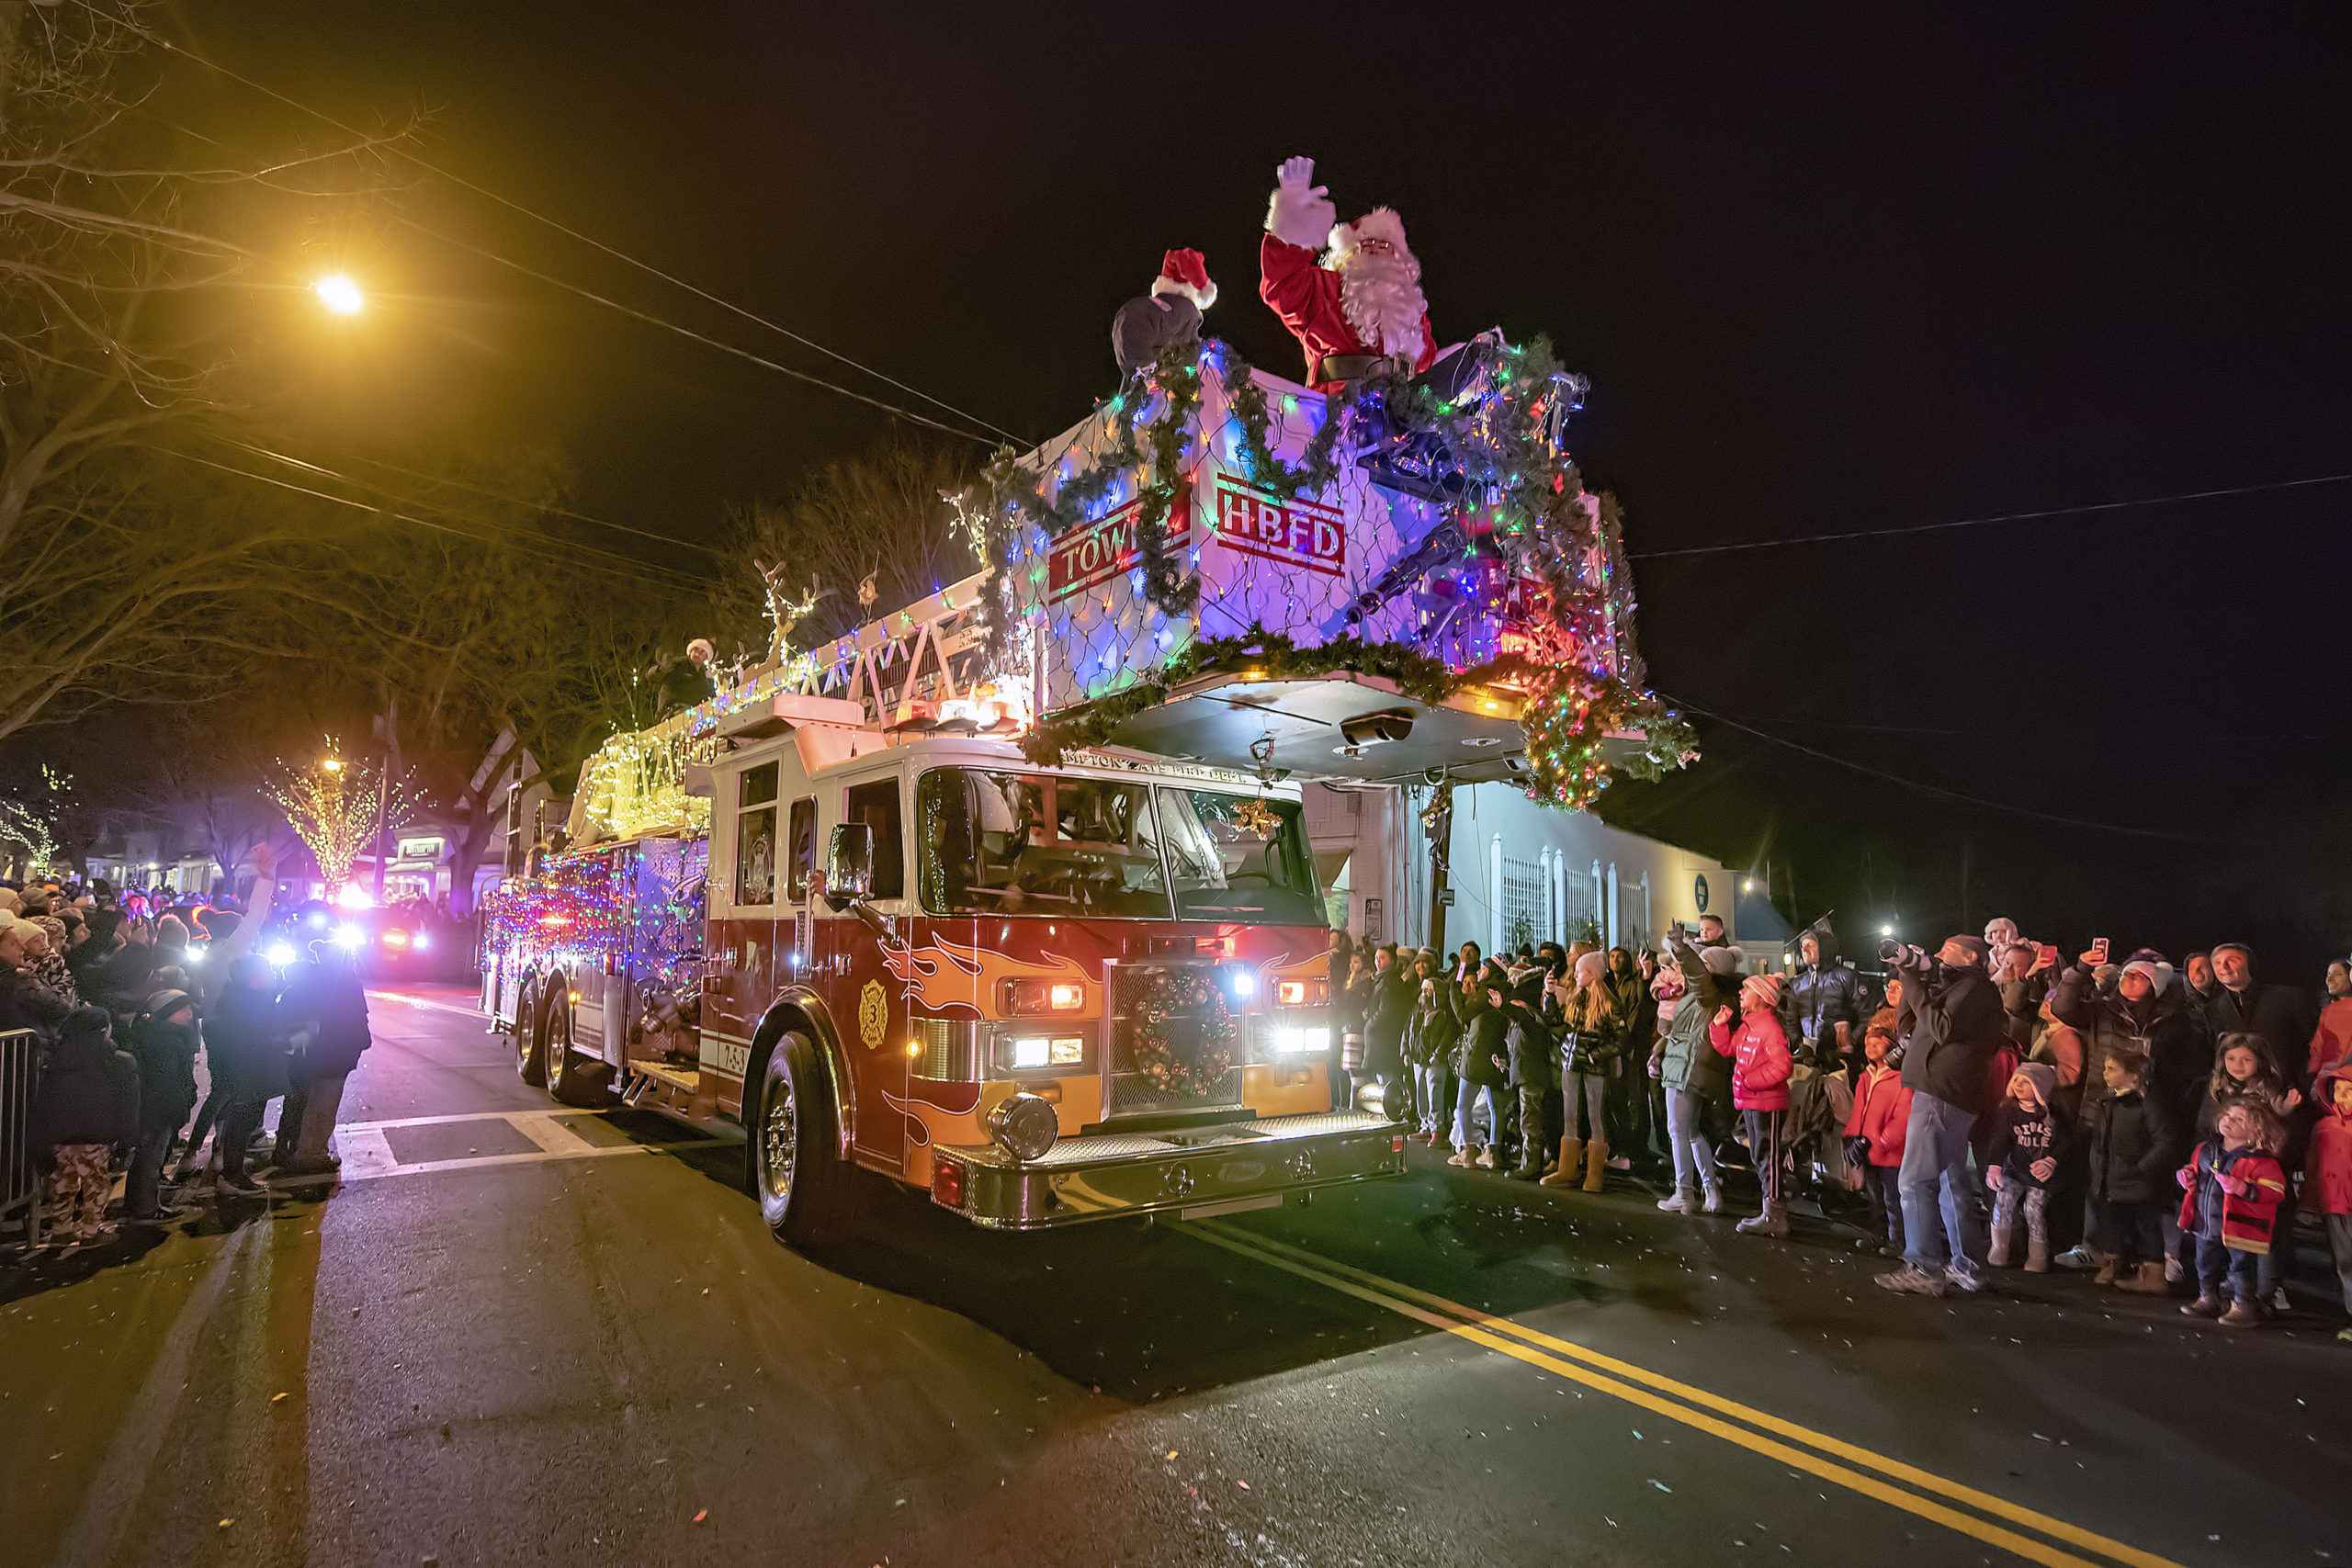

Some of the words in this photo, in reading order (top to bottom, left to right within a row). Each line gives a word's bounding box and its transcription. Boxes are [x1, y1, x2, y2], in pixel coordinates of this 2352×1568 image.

[1224, 493, 1340, 557] HBFD
[1061, 503, 1172, 581] TOW
[869, 1004, 876, 1023] 3
[2013, 1122, 2052, 1136] GIRLS
[2018, 1135, 2050, 1147] RULE
